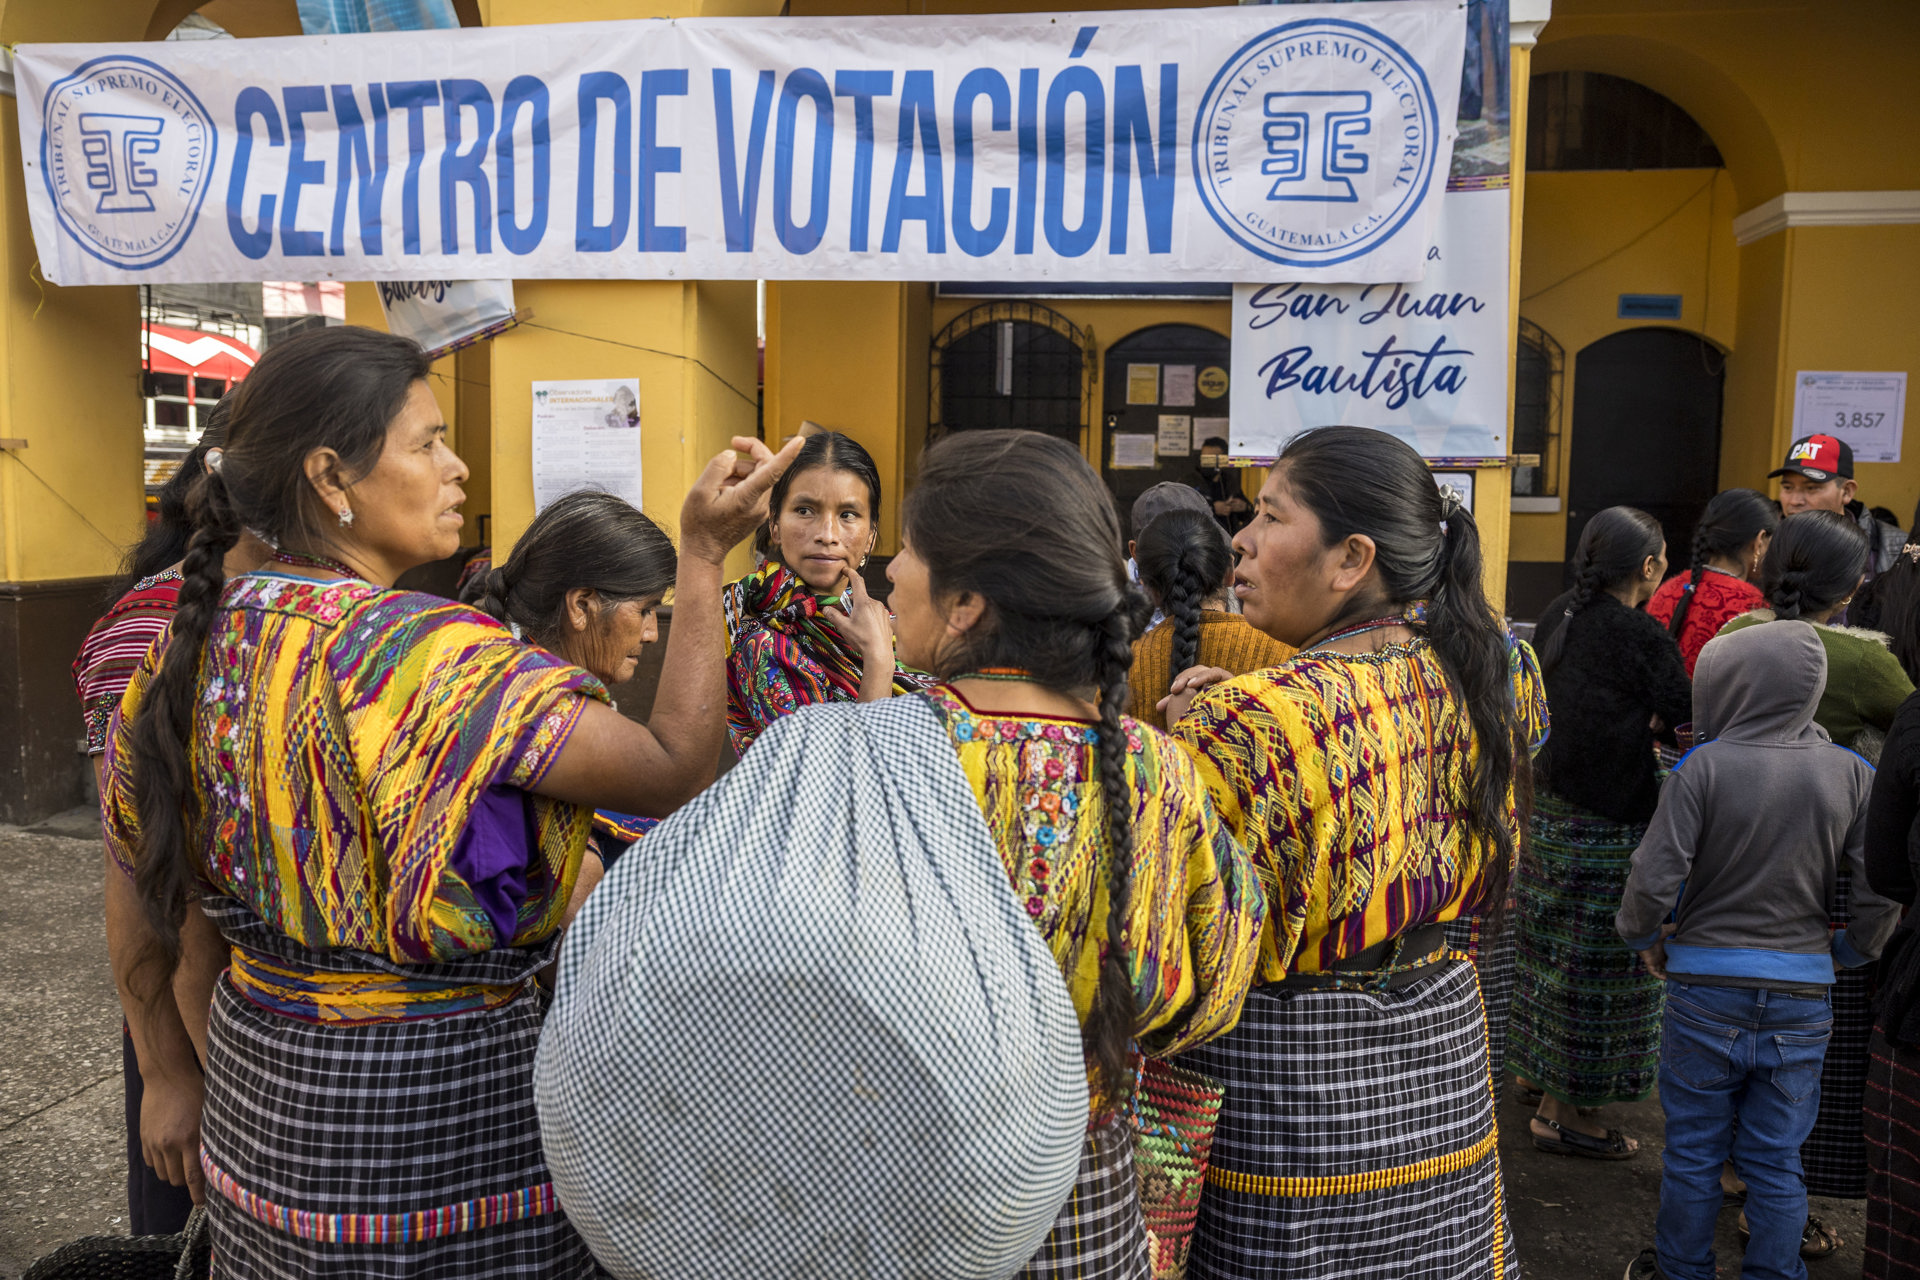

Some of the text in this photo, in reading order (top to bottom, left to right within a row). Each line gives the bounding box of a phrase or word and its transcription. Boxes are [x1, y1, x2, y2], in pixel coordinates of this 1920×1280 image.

[52, 74, 201, 201] TRIBUNAL SUPREMO ELECTORAL
[1213, 39, 1421, 189] TRIBUNAL SUPREMO ELECTORAL
[226, 26, 1179, 260] CENTRO DE VOTACIÓN
[87, 219, 177, 251] GUATEMALA C.A.
[1246, 211, 1383, 246] GUATEMALA C.A.
[1249, 283, 1486, 330] San Juan
[1258, 335, 1475, 410] Bautista
[1834, 412, 1886, 429] 3,857
[1790, 442, 1823, 460] CAT
